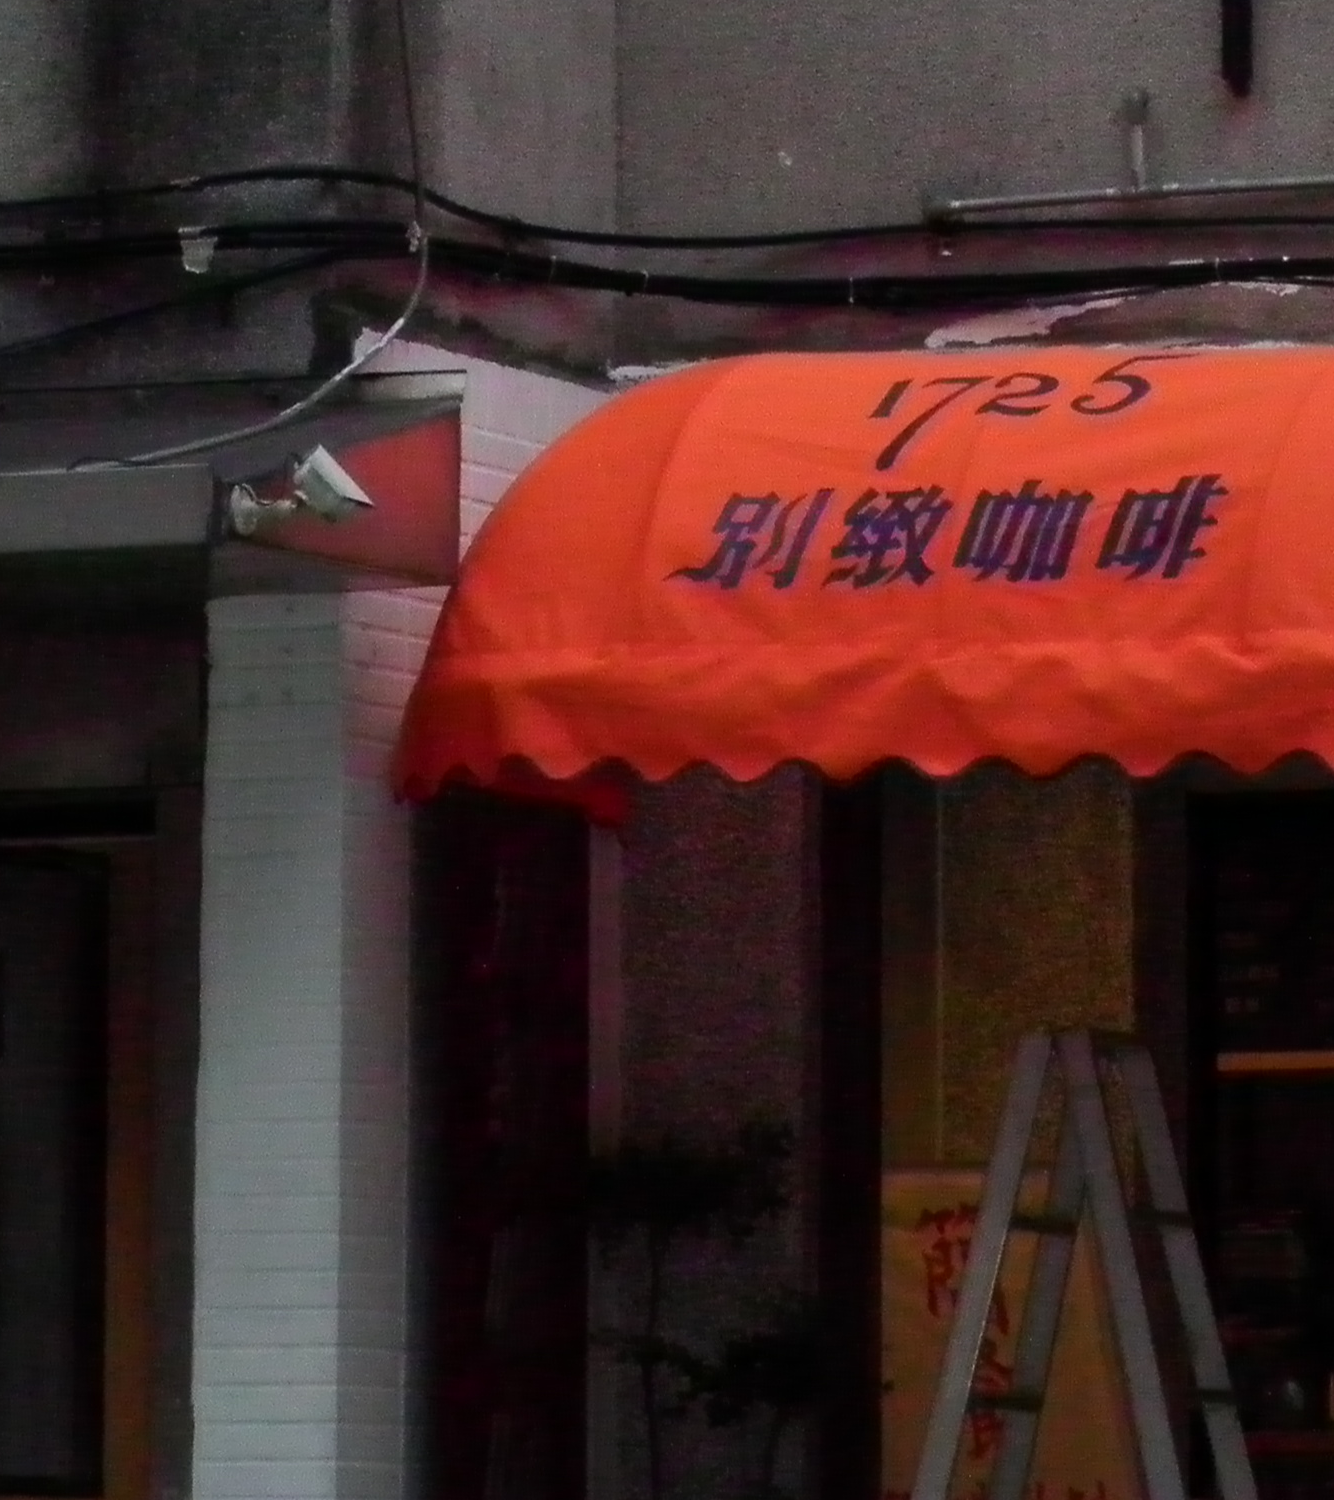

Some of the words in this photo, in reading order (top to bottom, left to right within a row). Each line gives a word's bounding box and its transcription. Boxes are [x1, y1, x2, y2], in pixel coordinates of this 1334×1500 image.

[869, 353, 1201, 471] 1725
[664, 474, 1228, 589] 別緻咖啡
